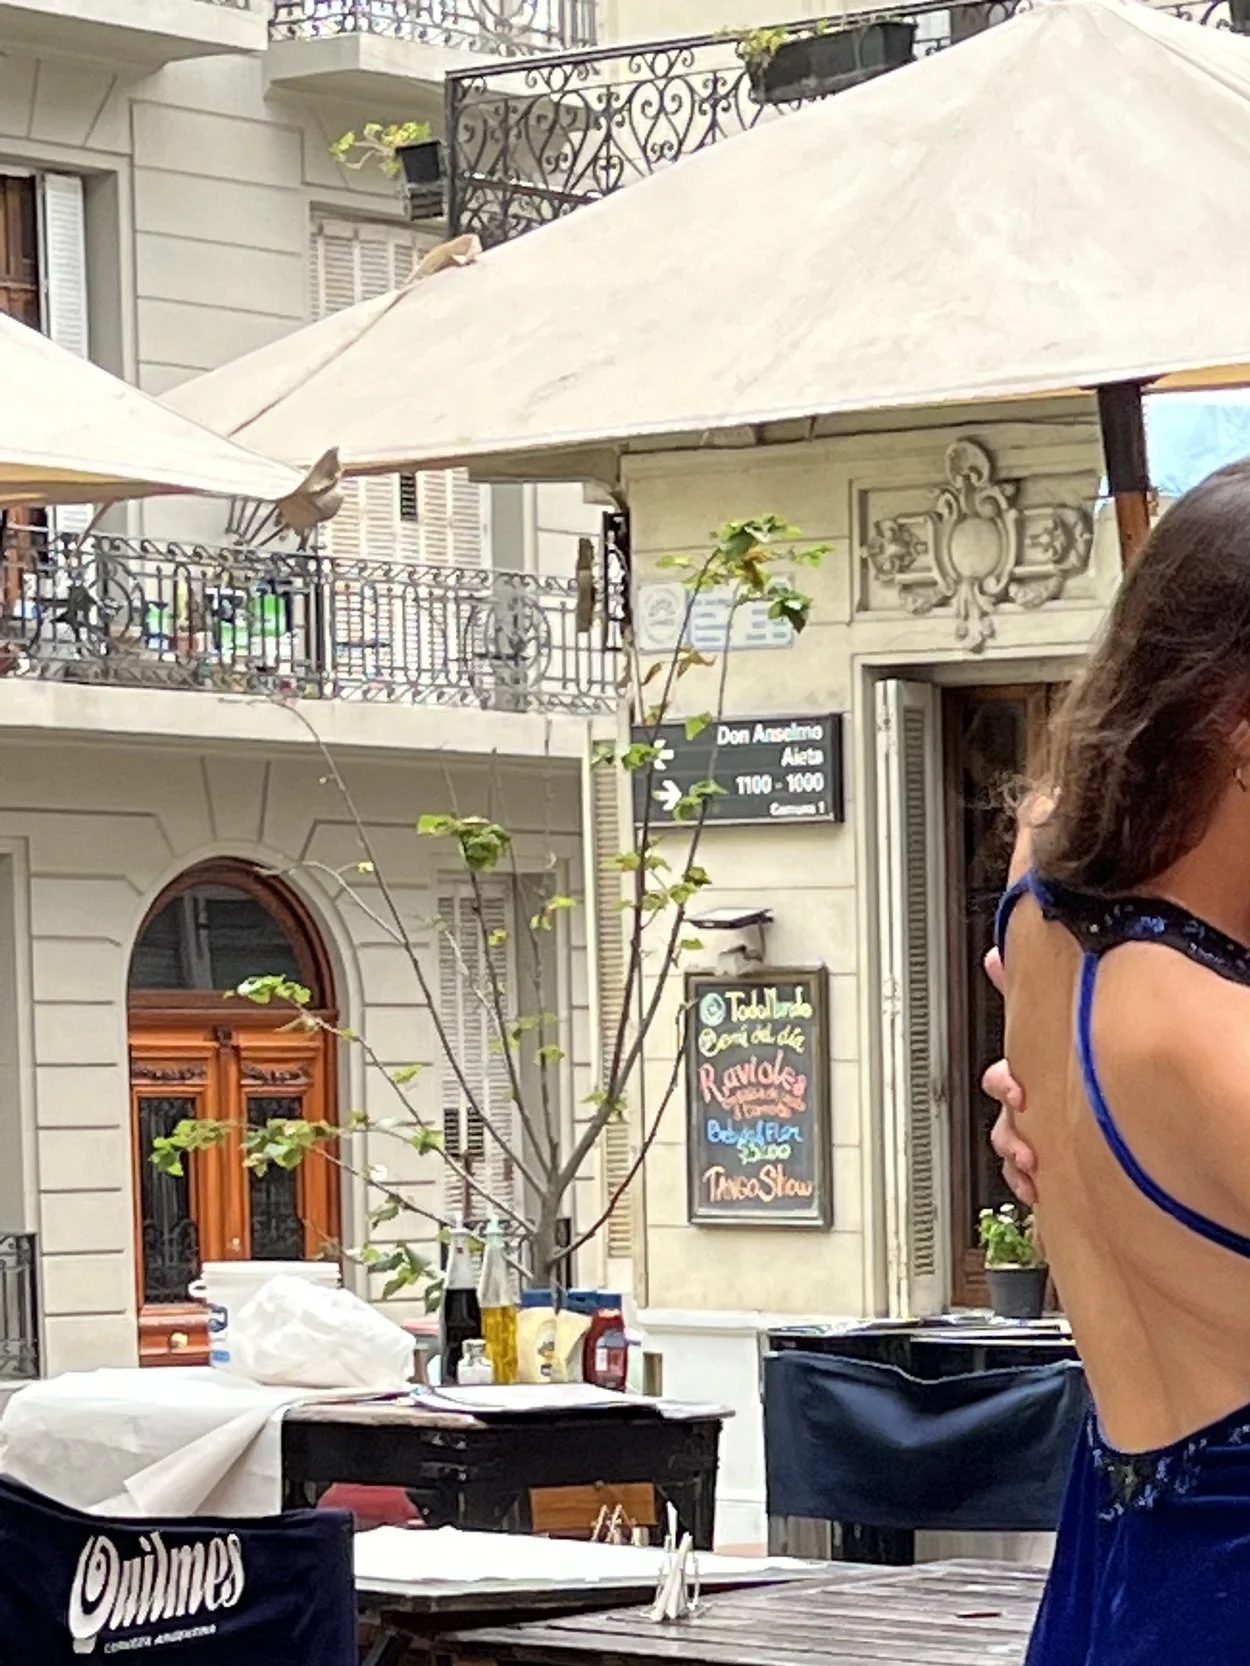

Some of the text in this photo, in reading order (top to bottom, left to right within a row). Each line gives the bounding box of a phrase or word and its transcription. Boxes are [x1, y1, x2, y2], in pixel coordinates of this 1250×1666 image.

[717, 722, 823, 746] Don Anselmo
[781, 747, 824, 767] Aieta
[735, 774, 772, 795] 1100
[785, 772, 824, 793] 1000
[69, 1531, 245, 1654] Quilmes
